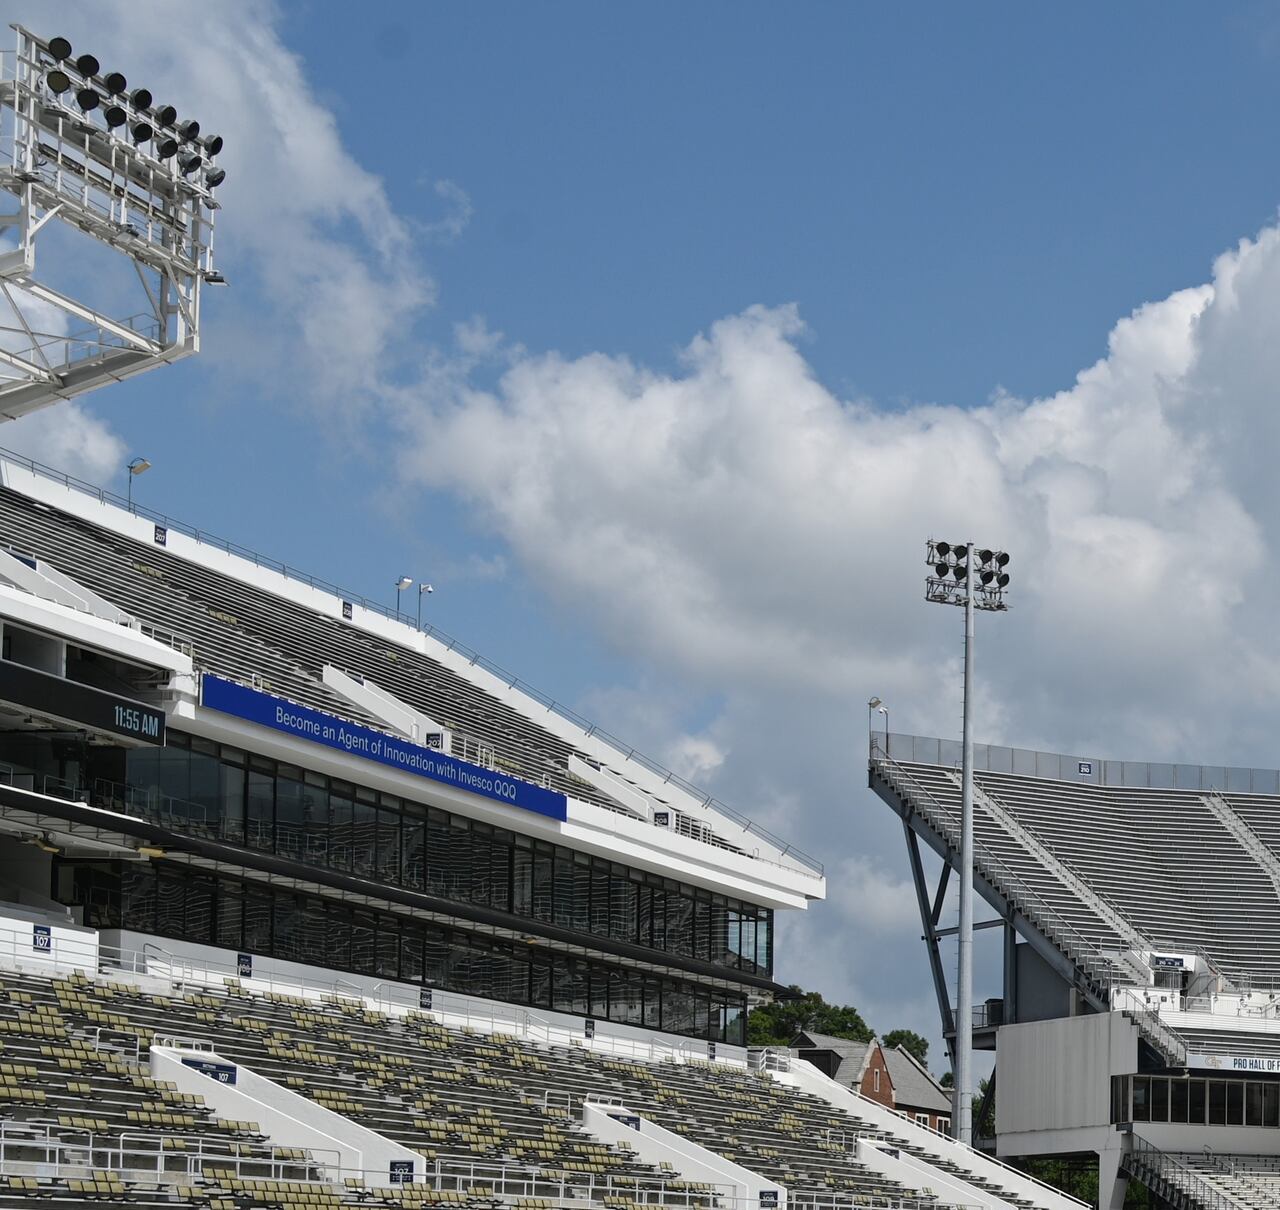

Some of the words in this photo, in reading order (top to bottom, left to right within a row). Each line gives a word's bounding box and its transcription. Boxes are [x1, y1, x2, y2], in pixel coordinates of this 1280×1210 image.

[114, 705, 139, 731] 11:55
[141, 715, 158, 737] AM
[276, 706, 320, 736] Become
[322, 725, 336, 741] an
[338, 727, 369, 755] Agent
[371, 738, 382, 756] of
[384, 742, 435, 774] Innovation
[436, 762, 456, 780] with
[458, 767, 493, 792] Invesco
[494, 779, 517, 800] QQQ
[35, 935, 49, 947] 107
[1233, 1058, 1247, 1068] PRO
[1249, 1059, 1265, 1070] HALL
[1267, 1060, 1275, 1070] OF
